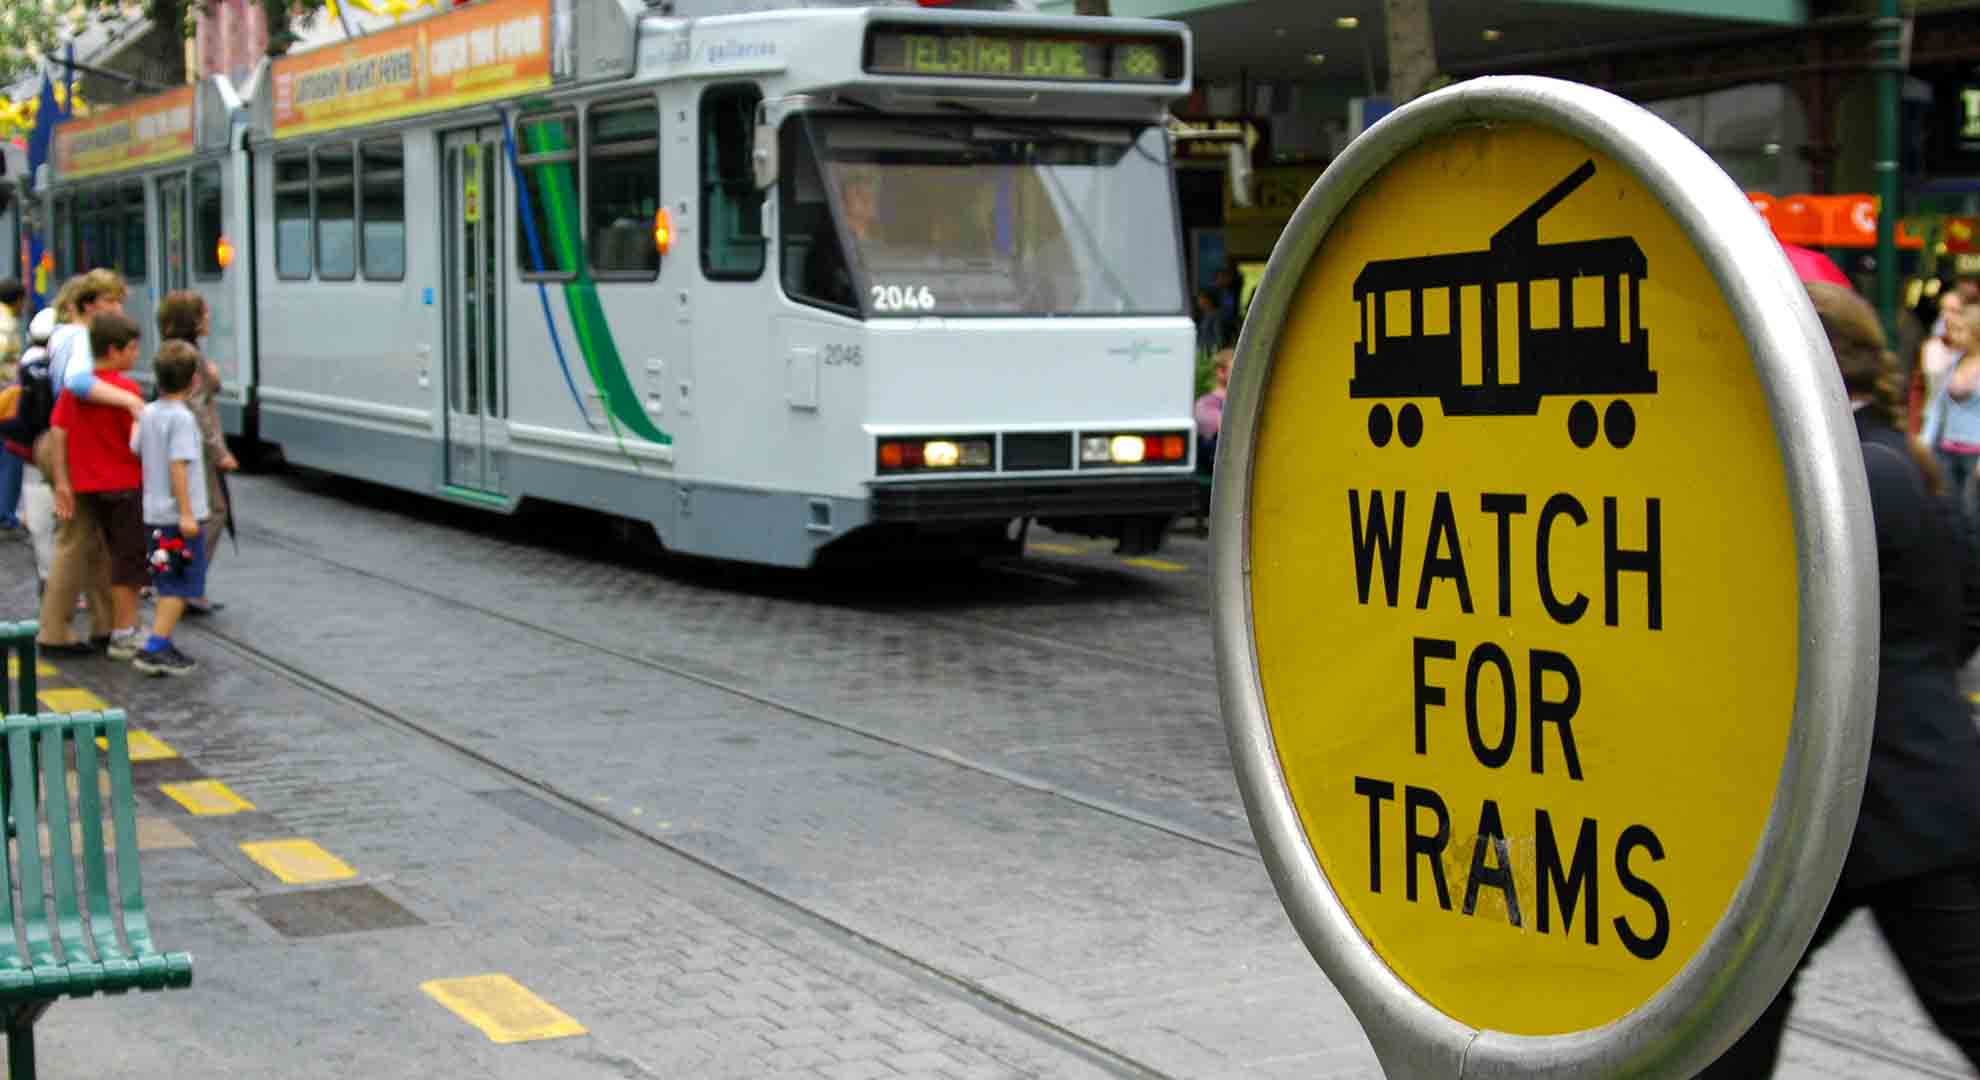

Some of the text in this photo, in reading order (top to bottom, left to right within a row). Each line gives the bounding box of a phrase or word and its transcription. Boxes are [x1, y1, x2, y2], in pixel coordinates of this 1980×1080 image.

[823, 343, 863, 367] 2046
[871, 285, 937, 311] 2046
[1348, 488, 1663, 631] WATCH
[1413, 636, 1585, 782] FOR
[1354, 775, 1671, 961] TRAMS
